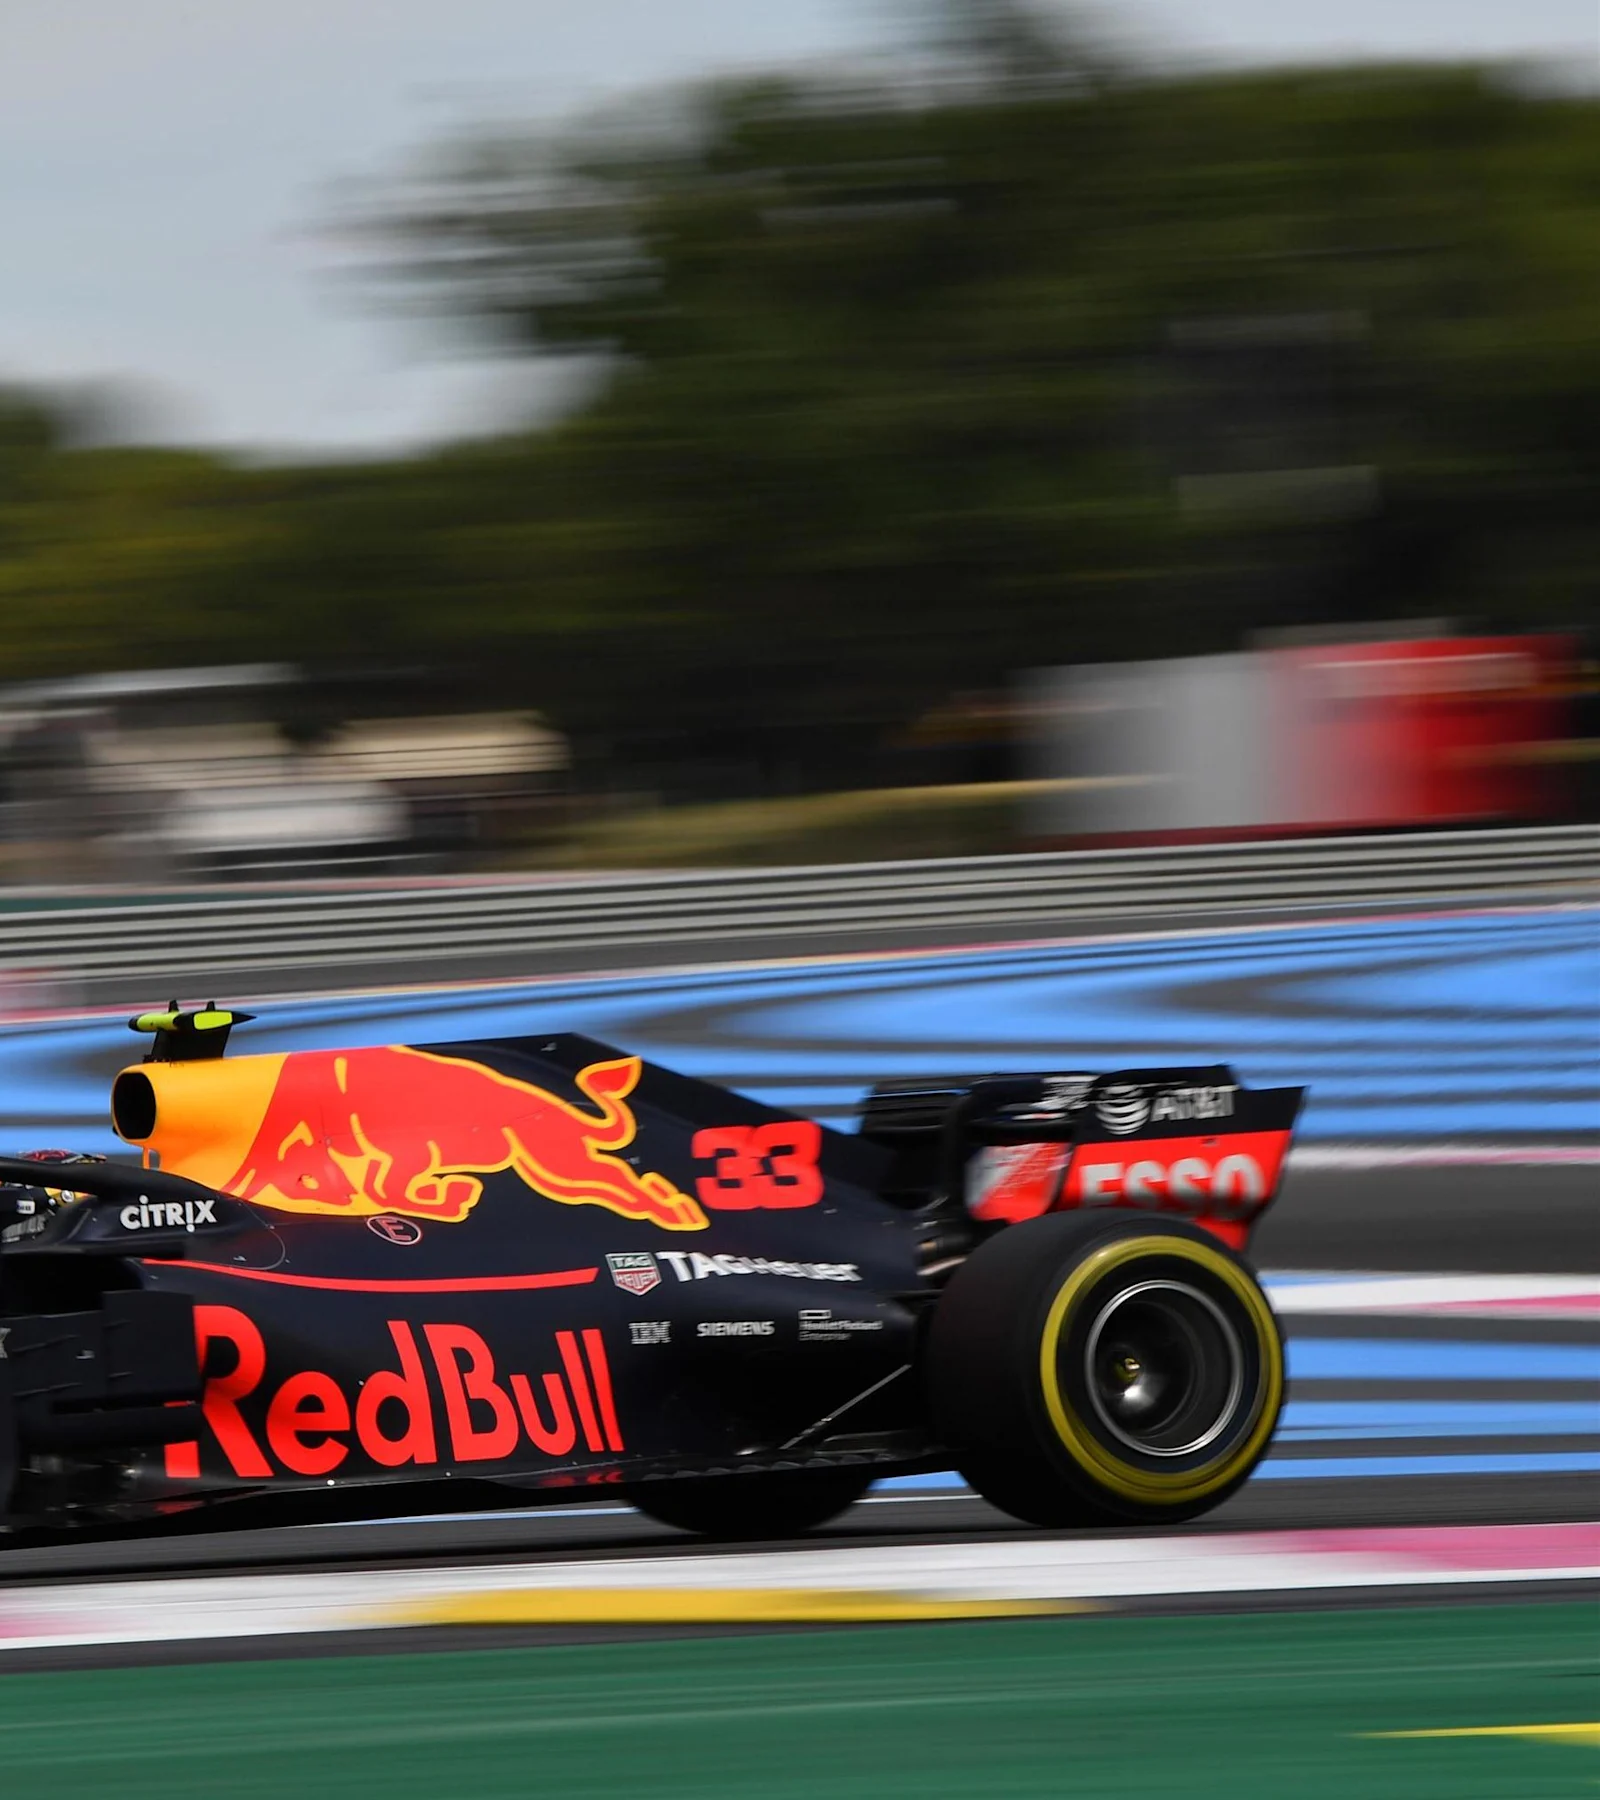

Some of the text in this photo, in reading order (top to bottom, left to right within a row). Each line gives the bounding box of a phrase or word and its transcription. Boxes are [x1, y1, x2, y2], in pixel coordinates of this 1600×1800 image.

[691, 1120, 824, 1210] 33
[611, 1256, 650, 1266] TAG
[617, 1272, 659, 1288] HEUER
[628, 1321, 672, 1345] IBM
[697, 1321, 775, 1337] SIEMENS
